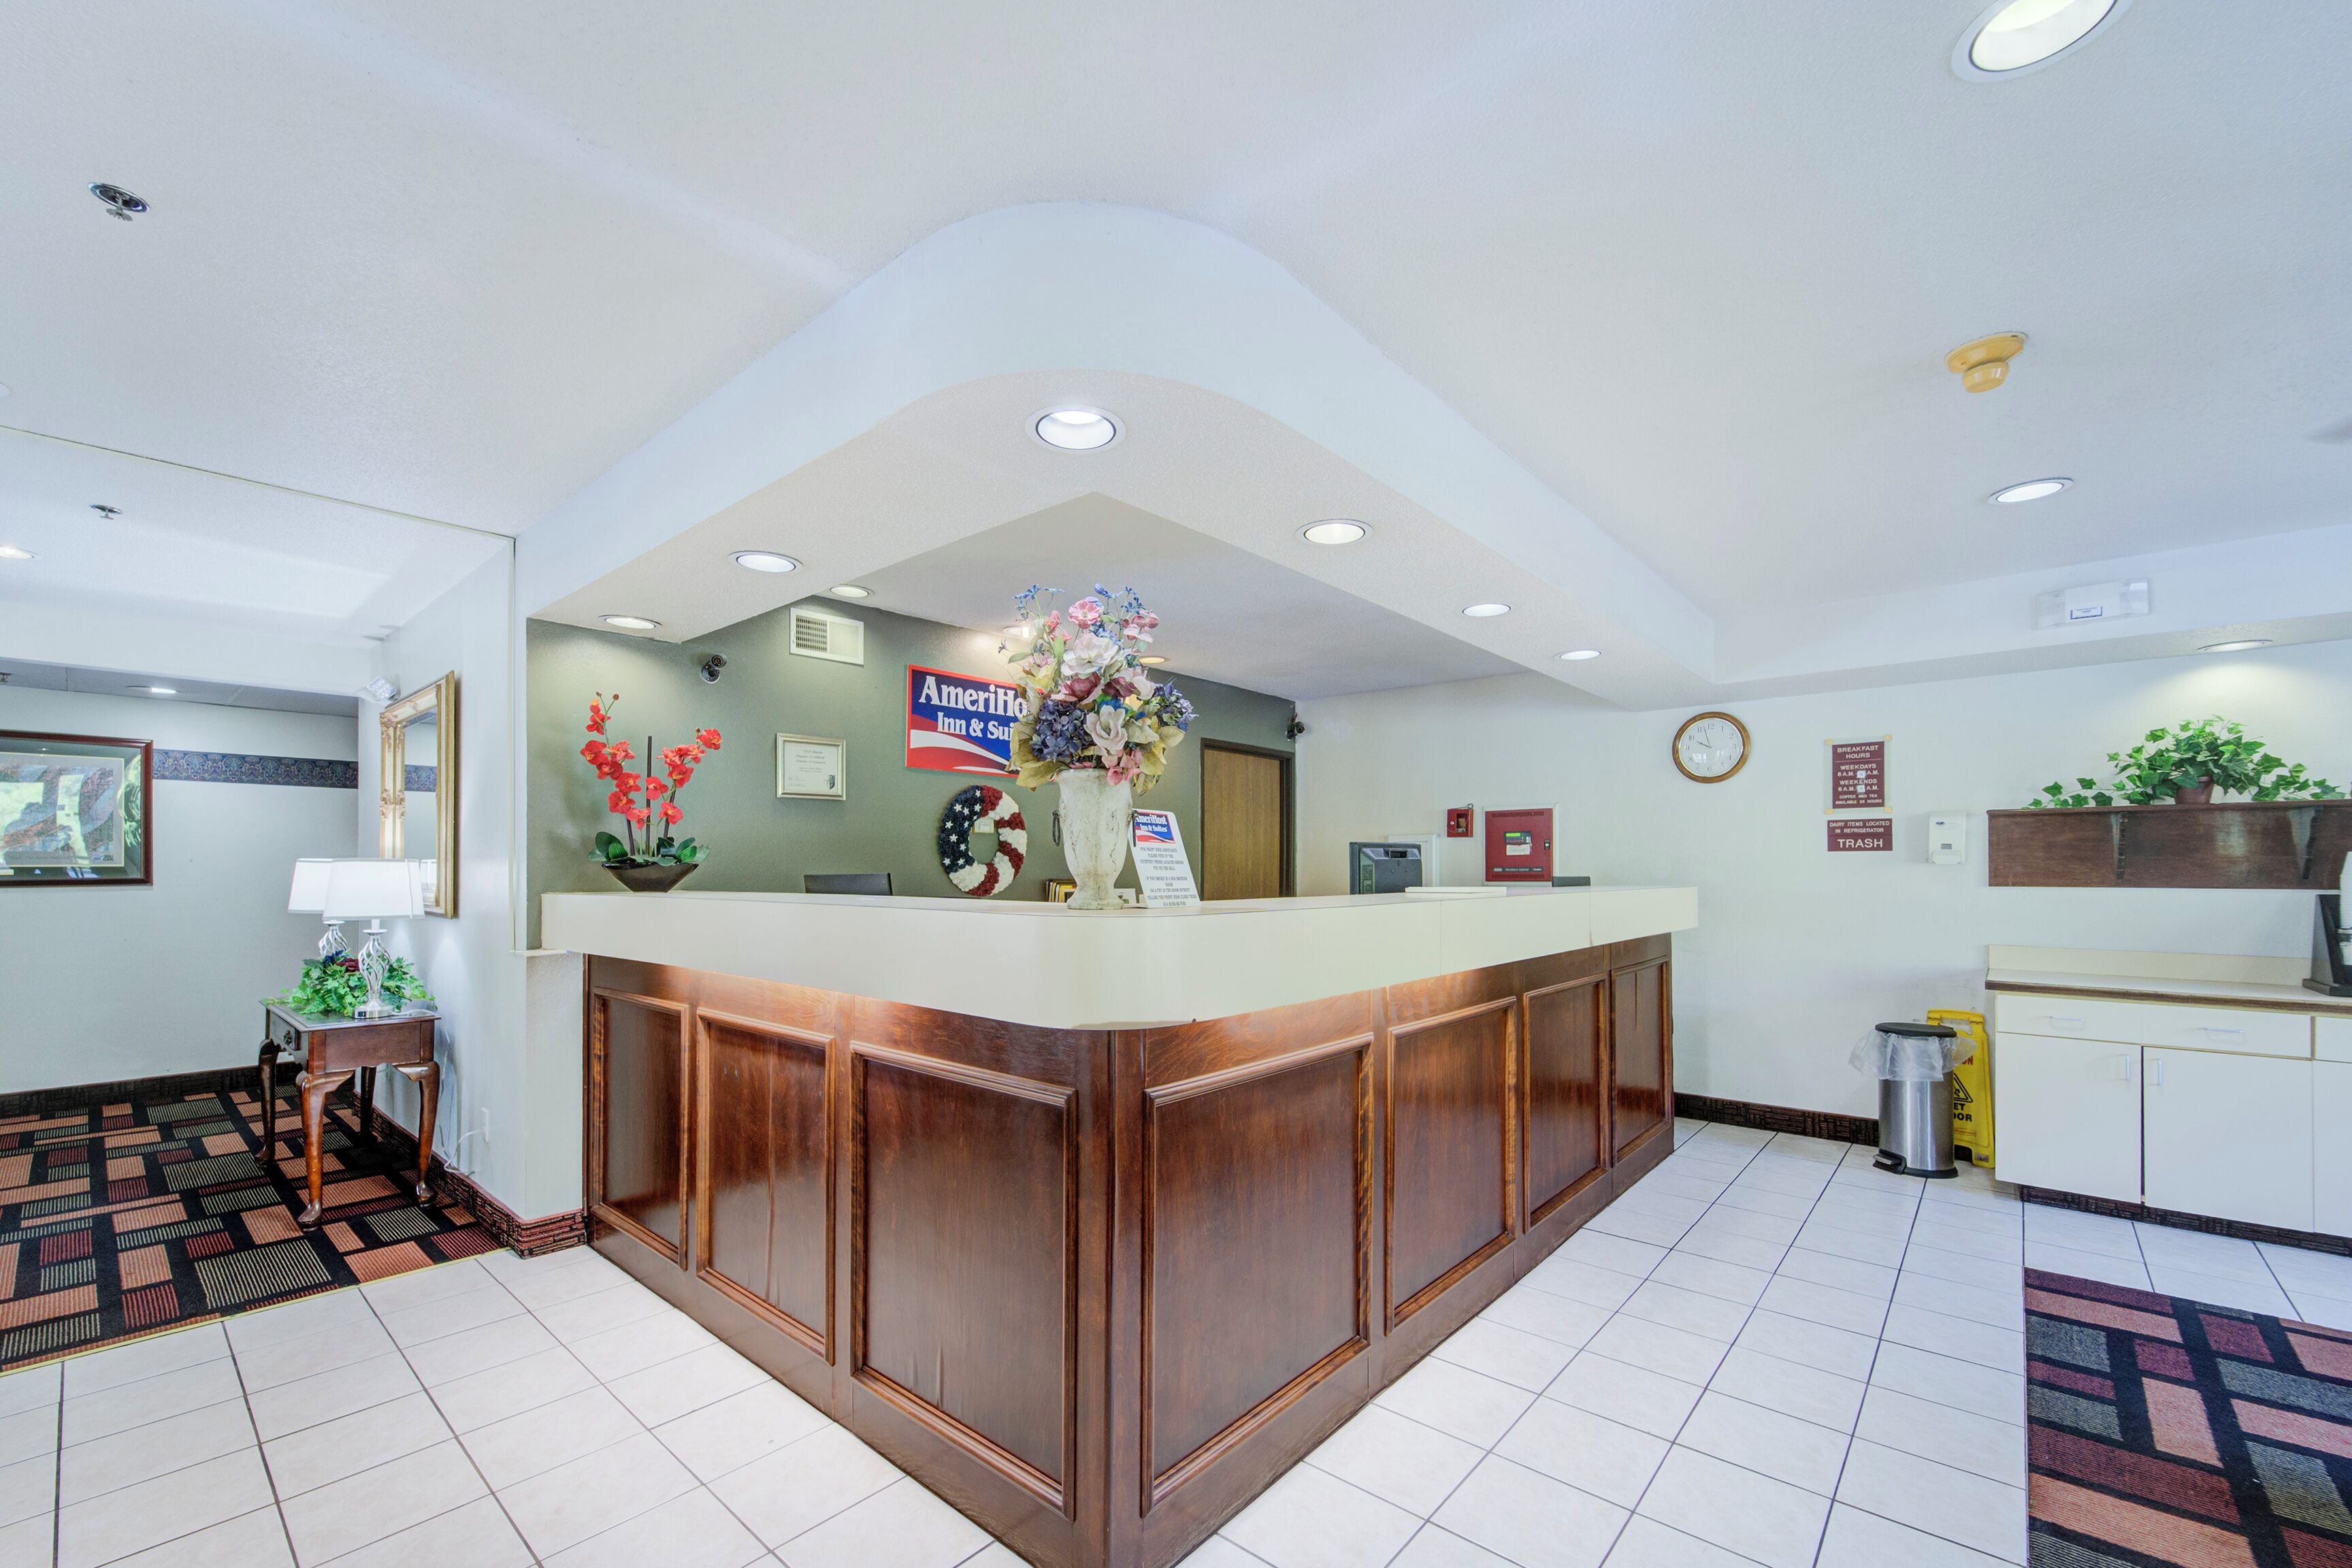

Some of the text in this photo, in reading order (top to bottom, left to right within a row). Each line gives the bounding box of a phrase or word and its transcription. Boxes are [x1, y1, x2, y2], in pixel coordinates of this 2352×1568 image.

[919, 675, 1030, 718] AmeriHo
[937, 712, 1013, 740] Inn & Sui
[1837, 838, 1883, 848] TRASH
[1954, 1102, 1965, 1111] ET
